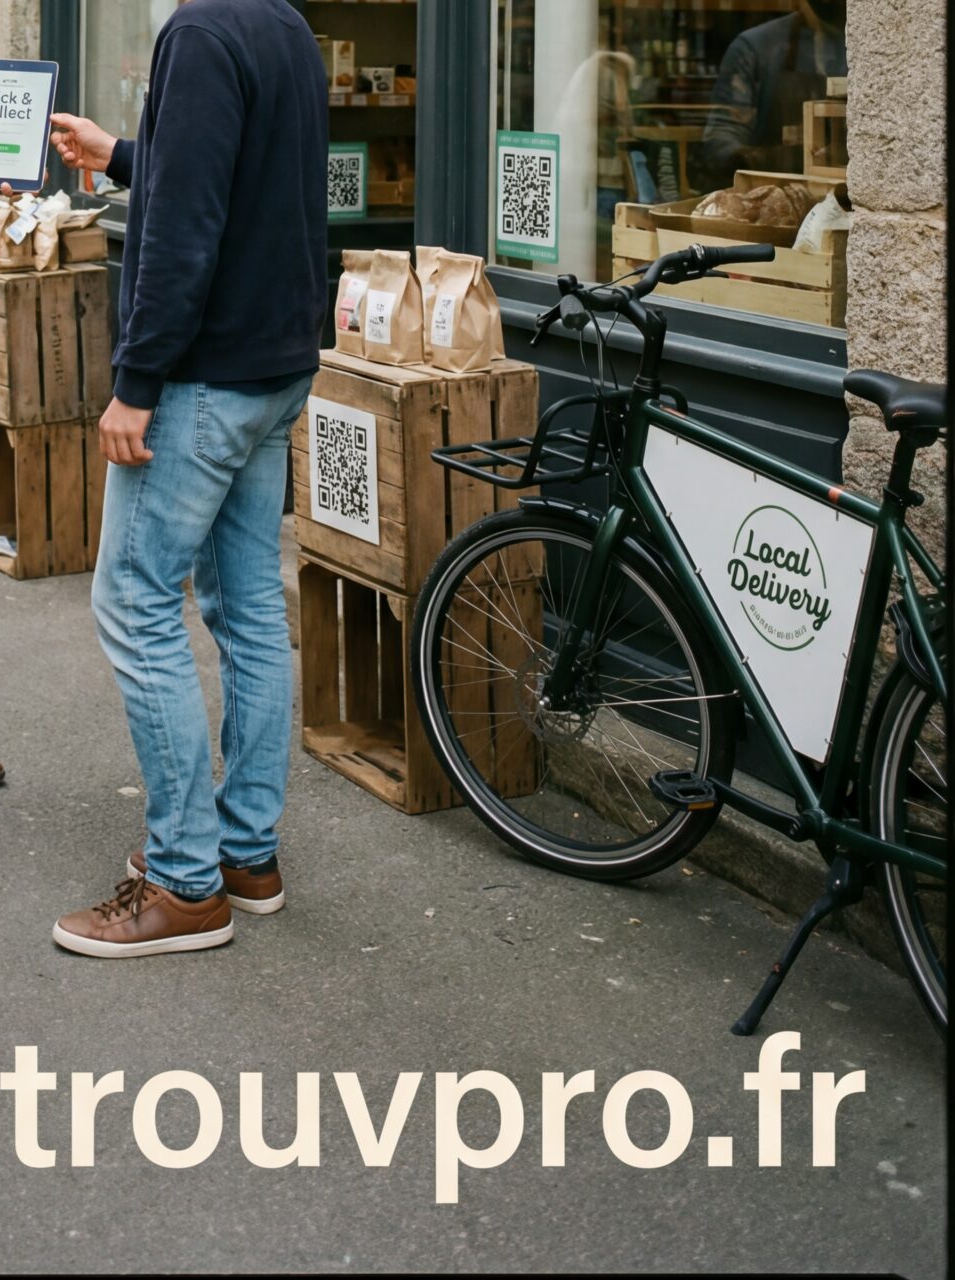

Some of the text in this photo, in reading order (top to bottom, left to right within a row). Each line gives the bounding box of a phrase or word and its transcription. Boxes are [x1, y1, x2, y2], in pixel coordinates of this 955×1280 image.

[21, 92, 32, 106] &
[743, 529, 811, 577] Local
[727, 558, 832, 631] Delivery
